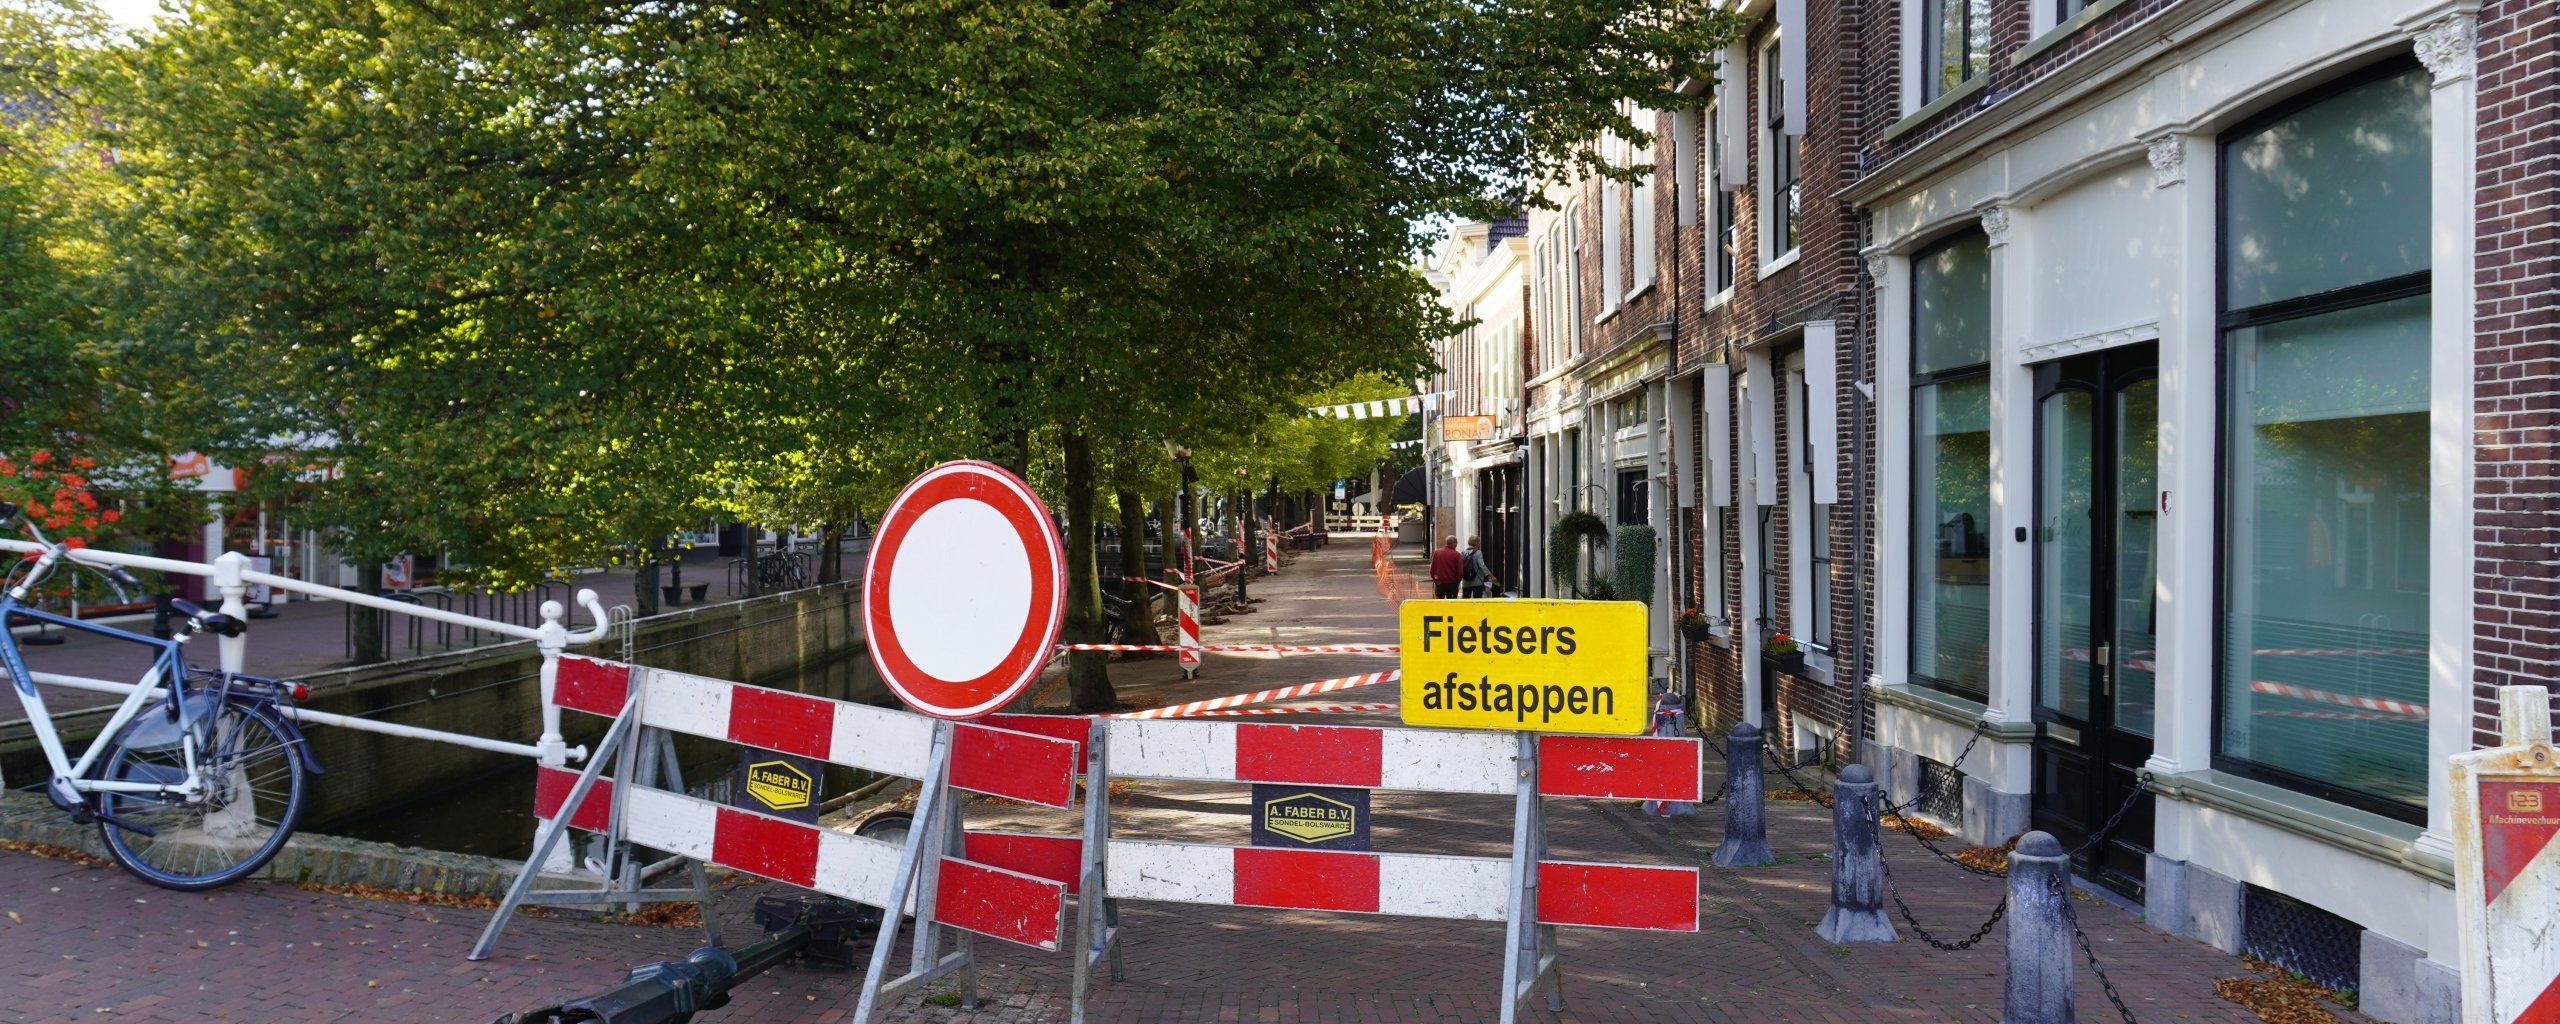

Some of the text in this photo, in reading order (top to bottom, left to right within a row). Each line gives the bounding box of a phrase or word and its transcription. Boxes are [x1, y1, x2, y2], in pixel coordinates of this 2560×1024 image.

[1445, 428, 1480, 439] RONA
[1423, 615, 1577, 656] Fietsers
[1422, 672, 1614, 724] afstappen
[752, 770, 807, 792] A. FABER B.V.
[753, 782, 803, 800] SONDEL-BOLSWARD
[1269, 806, 1350, 821] A. FABER B.V.
[1274, 819, 1345, 830] SONDEL-BOLSWARD
